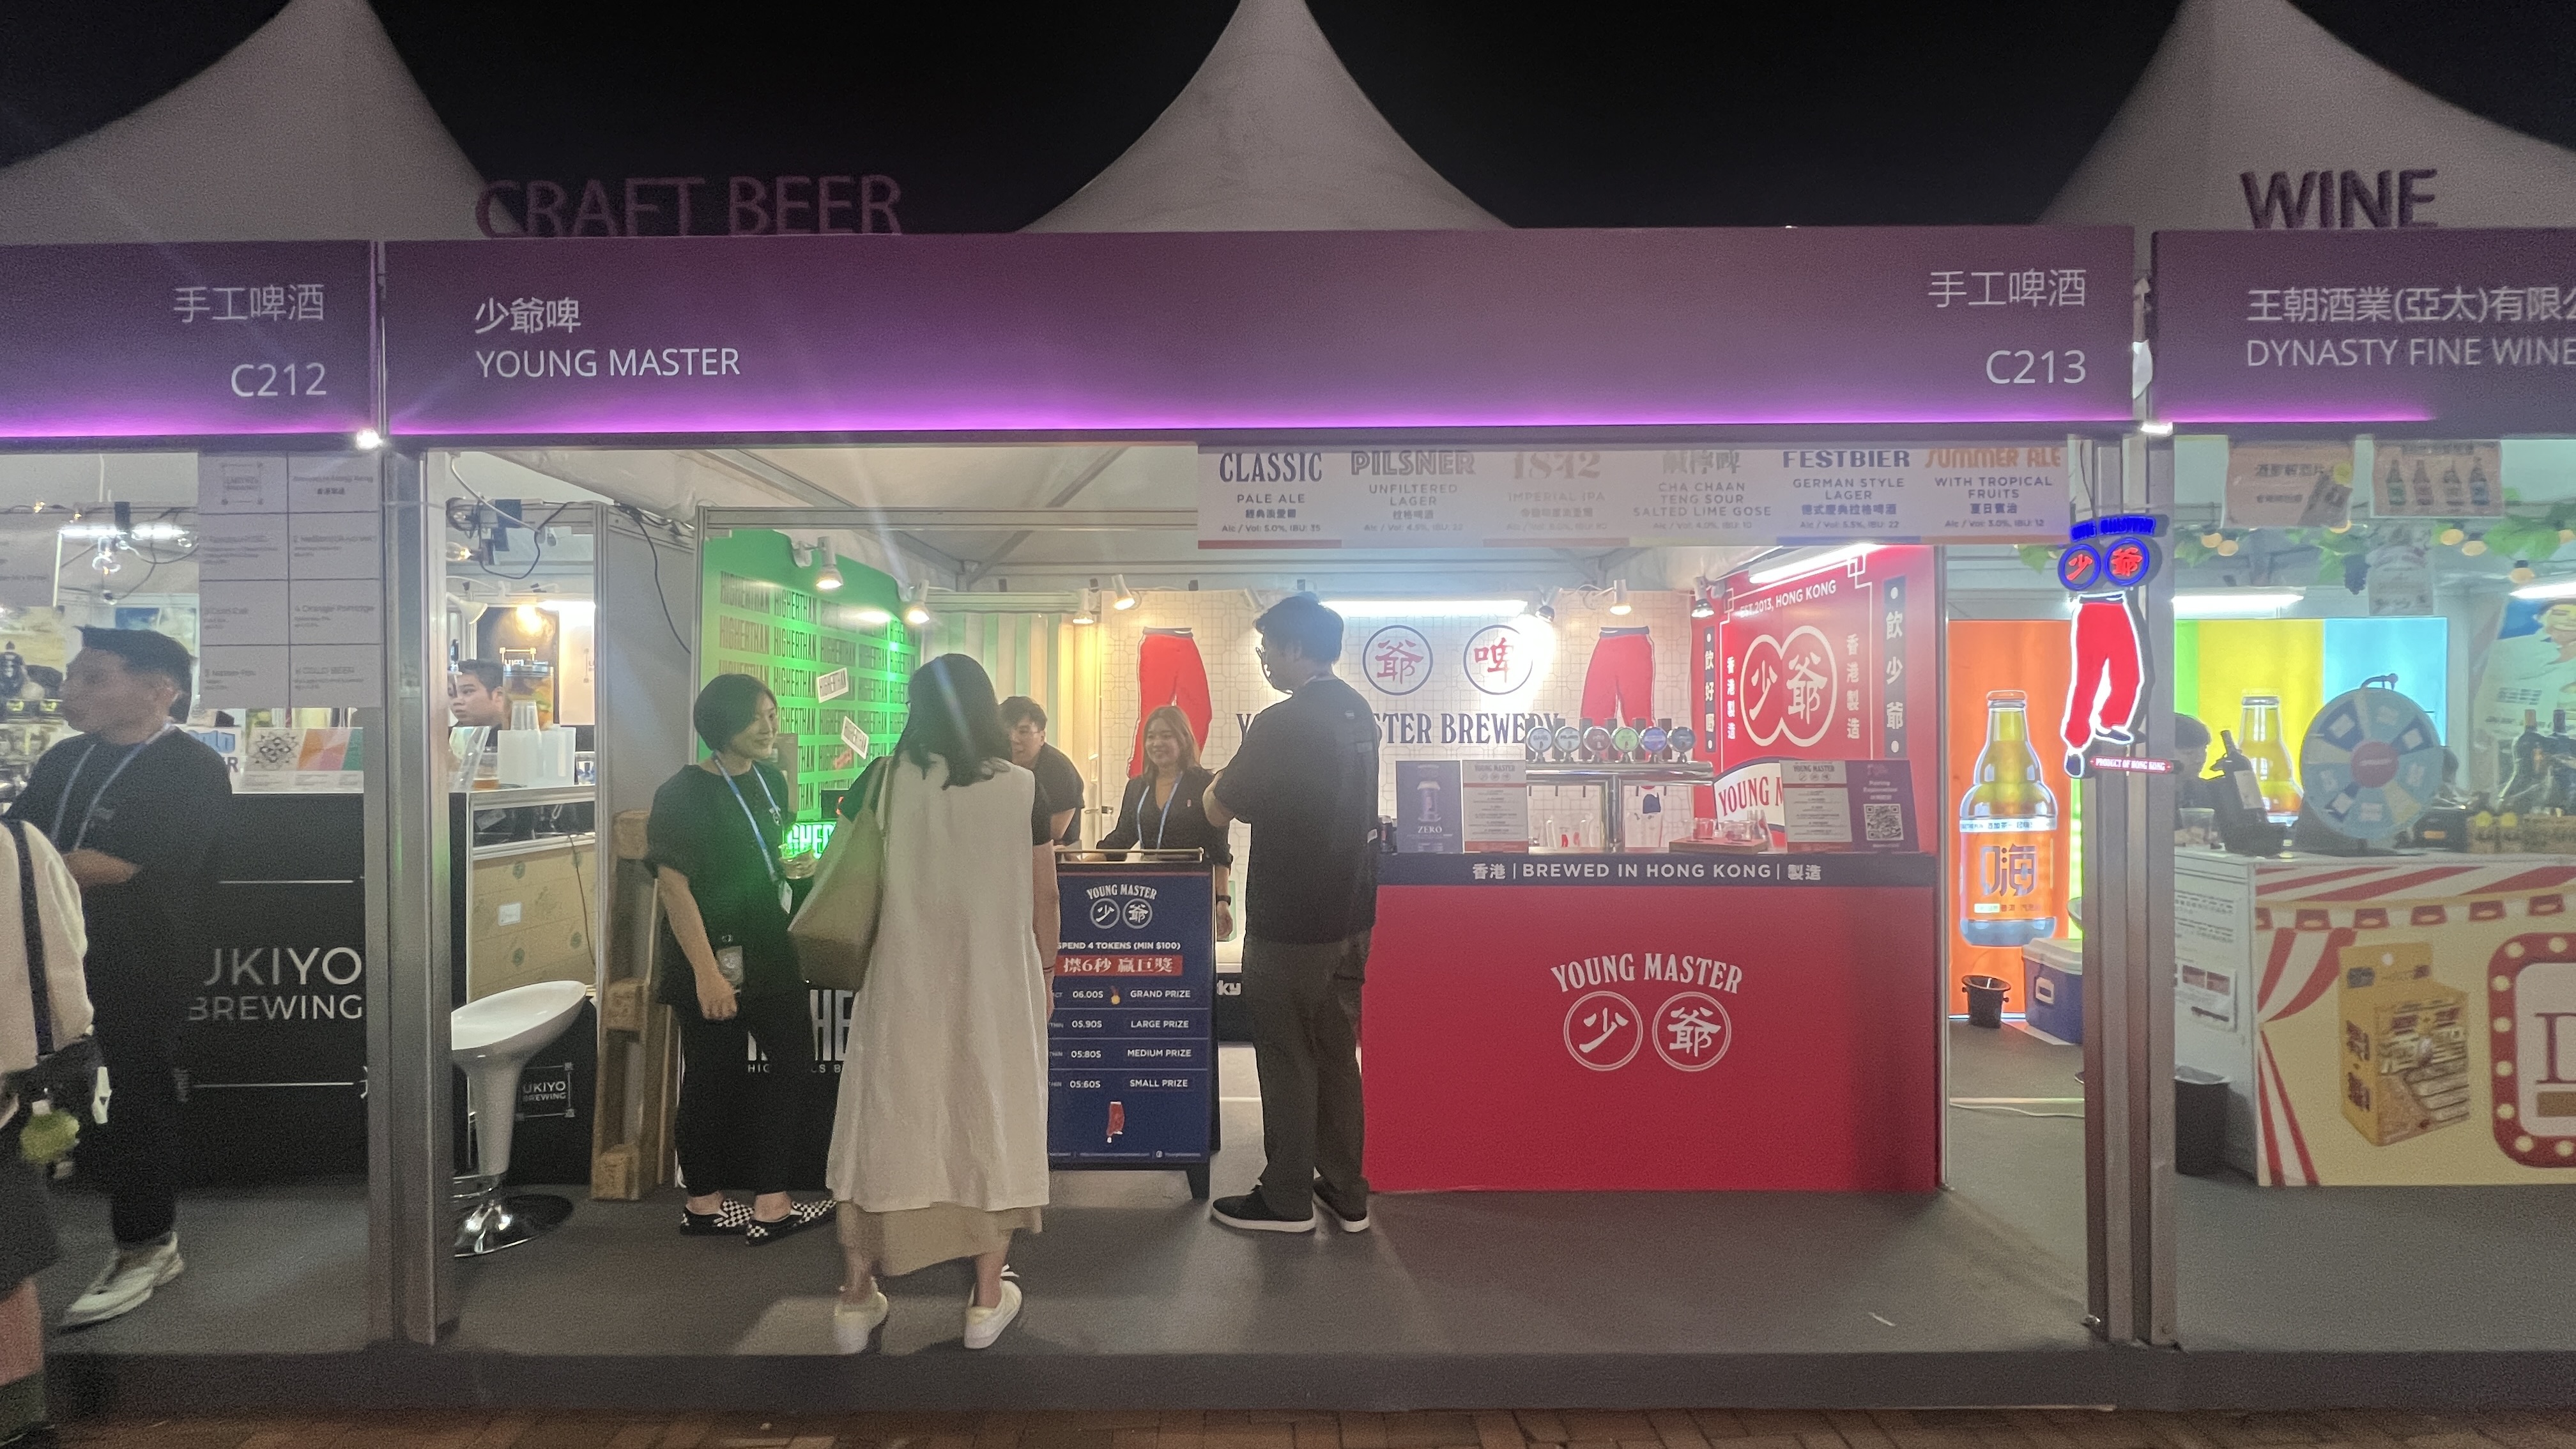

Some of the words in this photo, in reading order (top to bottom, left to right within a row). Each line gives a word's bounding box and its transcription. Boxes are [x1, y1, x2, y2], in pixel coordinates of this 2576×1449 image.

[475, 176, 705, 238] CRAFT
[729, 174, 902, 236] BEER
[2240, 167, 2437, 231] WINE
[1928, 268, 2086, 309] 手工啤酒
[173, 283, 325, 323] 手工啤酒
[475, 296, 581, 334] 少爺啤
[2247, 339, 2398, 366] DYNASTY
[2410, 339, 2481, 365] FINE
[2491, 338, 2576, 365] WINE
[475, 349, 597, 378] YOUNG
[609, 347, 740, 377] MASTER
[1986, 349, 2087, 385] C213
[231, 362, 326, 397] C212
[1351, 450, 1476, 475] PILSNER
[1514, 452, 1601, 479] 1842
[1783, 450, 1910, 468] FESTBIER
[1925, 448, 2018, 469] SUMMER
[2027, 447, 2061, 468] ALE
[1220, 452, 1322, 482] CLASSIC
[1369, 484, 1457, 494] UNFILTERED
[1659, 482, 1687, 492] CHA
[1694, 482, 1745, 492] CHAAN
[1793, 478, 1854, 488] GERMAN
[1860, 477, 1904, 487] STYLE
[1935, 477, 1972, 486] WITH
[1980, 476, 2052, 486] TROPICAL
[1238, 494, 1272, 503] PALE
[1278, 494, 1305, 503] ALE
[1390, 496, 1437, 506] LAGER
[1508, 491, 1576, 502] IMPERIAL
[1583, 491, 1605, 502] IPA
[1661, 494, 1699, 504] TENG
[1705, 494, 1744, 504] SOUR
[1825, 490, 1872, 500] LAGER
[1968, 489, 2020, 499] FRUITS
[1633, 507, 1687, 517] SALTED
[1694, 507, 1727, 516] LIME
[1733, 506, 1772, 516] GOSE
[1776, 588, 1803, 608] HONG
[1805, 579, 1837, 599] KONG
[1749, 652, 1827, 724] 少爺
[1374, 713, 1432, 744] TER
[1719, 776, 1769, 816] YOUNG
[1418, 825, 1443, 834] ZERO
[1473, 863, 1506, 880] 香港
[1522, 864, 1609, 877] BREWED
[1618, 864, 1637, 877] IN
[1646, 864, 1705, 877] HONG
[1713, 864, 1772, 877] KONG
[1788, 864, 1821, 880] 製造
[1086, 884, 1117, 900] YOUNG
[1120, 884, 1157, 900] MASTER
[1096, 903, 1149, 923] 少爺
[1133, 942, 1153, 950] (MIN
[1156, 942, 1181, 950] $100)
[1551, 953, 1635, 992] YOUNG
[1644, 953, 1742, 994] MASTER
[1165, 990, 1191, 998] PRIZE
[189, 995, 362, 1021] BREWING
[1163, 1020, 1189, 1028] PRIZE
[1579, 1006, 1721, 1057] 少爺
[1127, 1049, 1163, 1057] MEDIUM
[1165, 1049, 1192, 1057] PRIZE
[524, 1081, 566, 1093] UKIYO
[1130, 1079, 1160, 1087] SMALL
